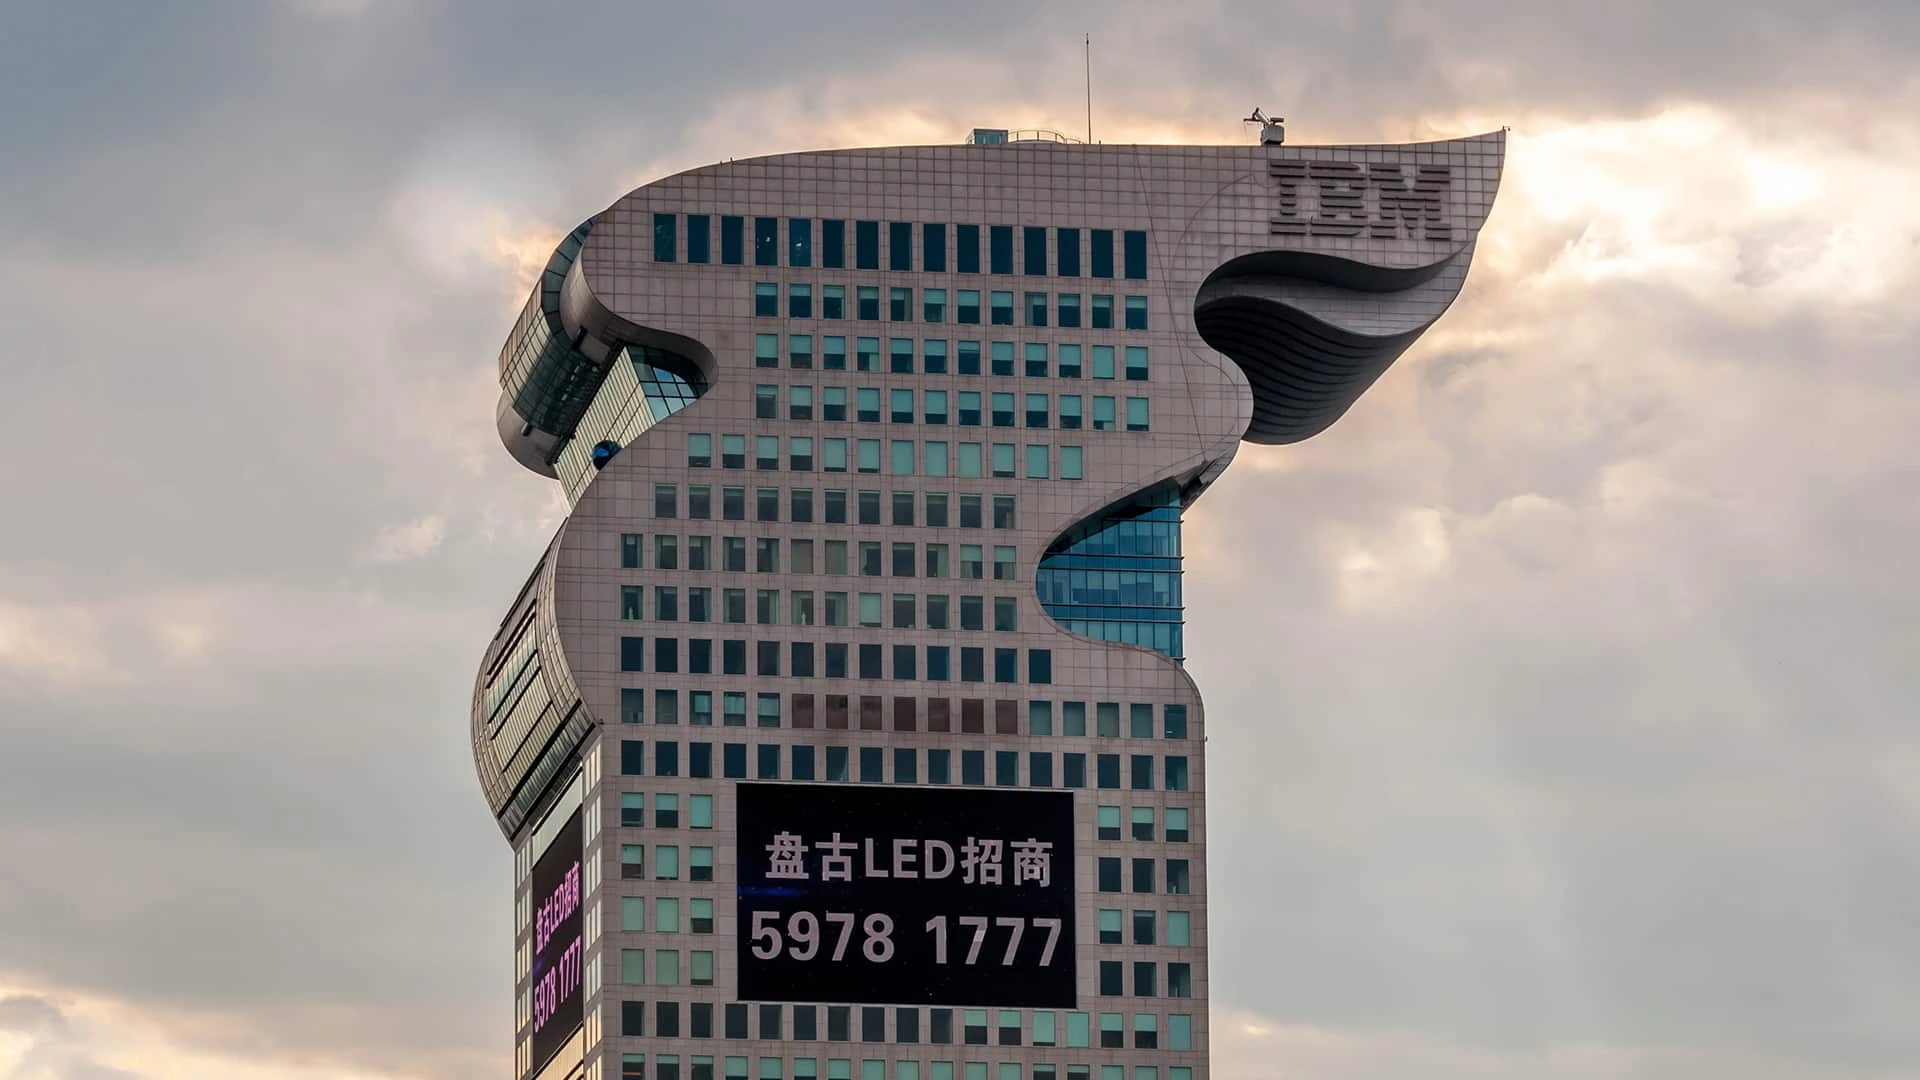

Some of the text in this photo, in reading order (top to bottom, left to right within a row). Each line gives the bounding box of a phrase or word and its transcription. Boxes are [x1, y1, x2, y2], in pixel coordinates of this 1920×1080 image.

[1269, 159, 1450, 239] IBM
[765, 831, 1053, 887] 盘古LED招商
[751, 911, 1062, 967] 5978 1777
[534, 935, 581, 1033] 5978 1777
